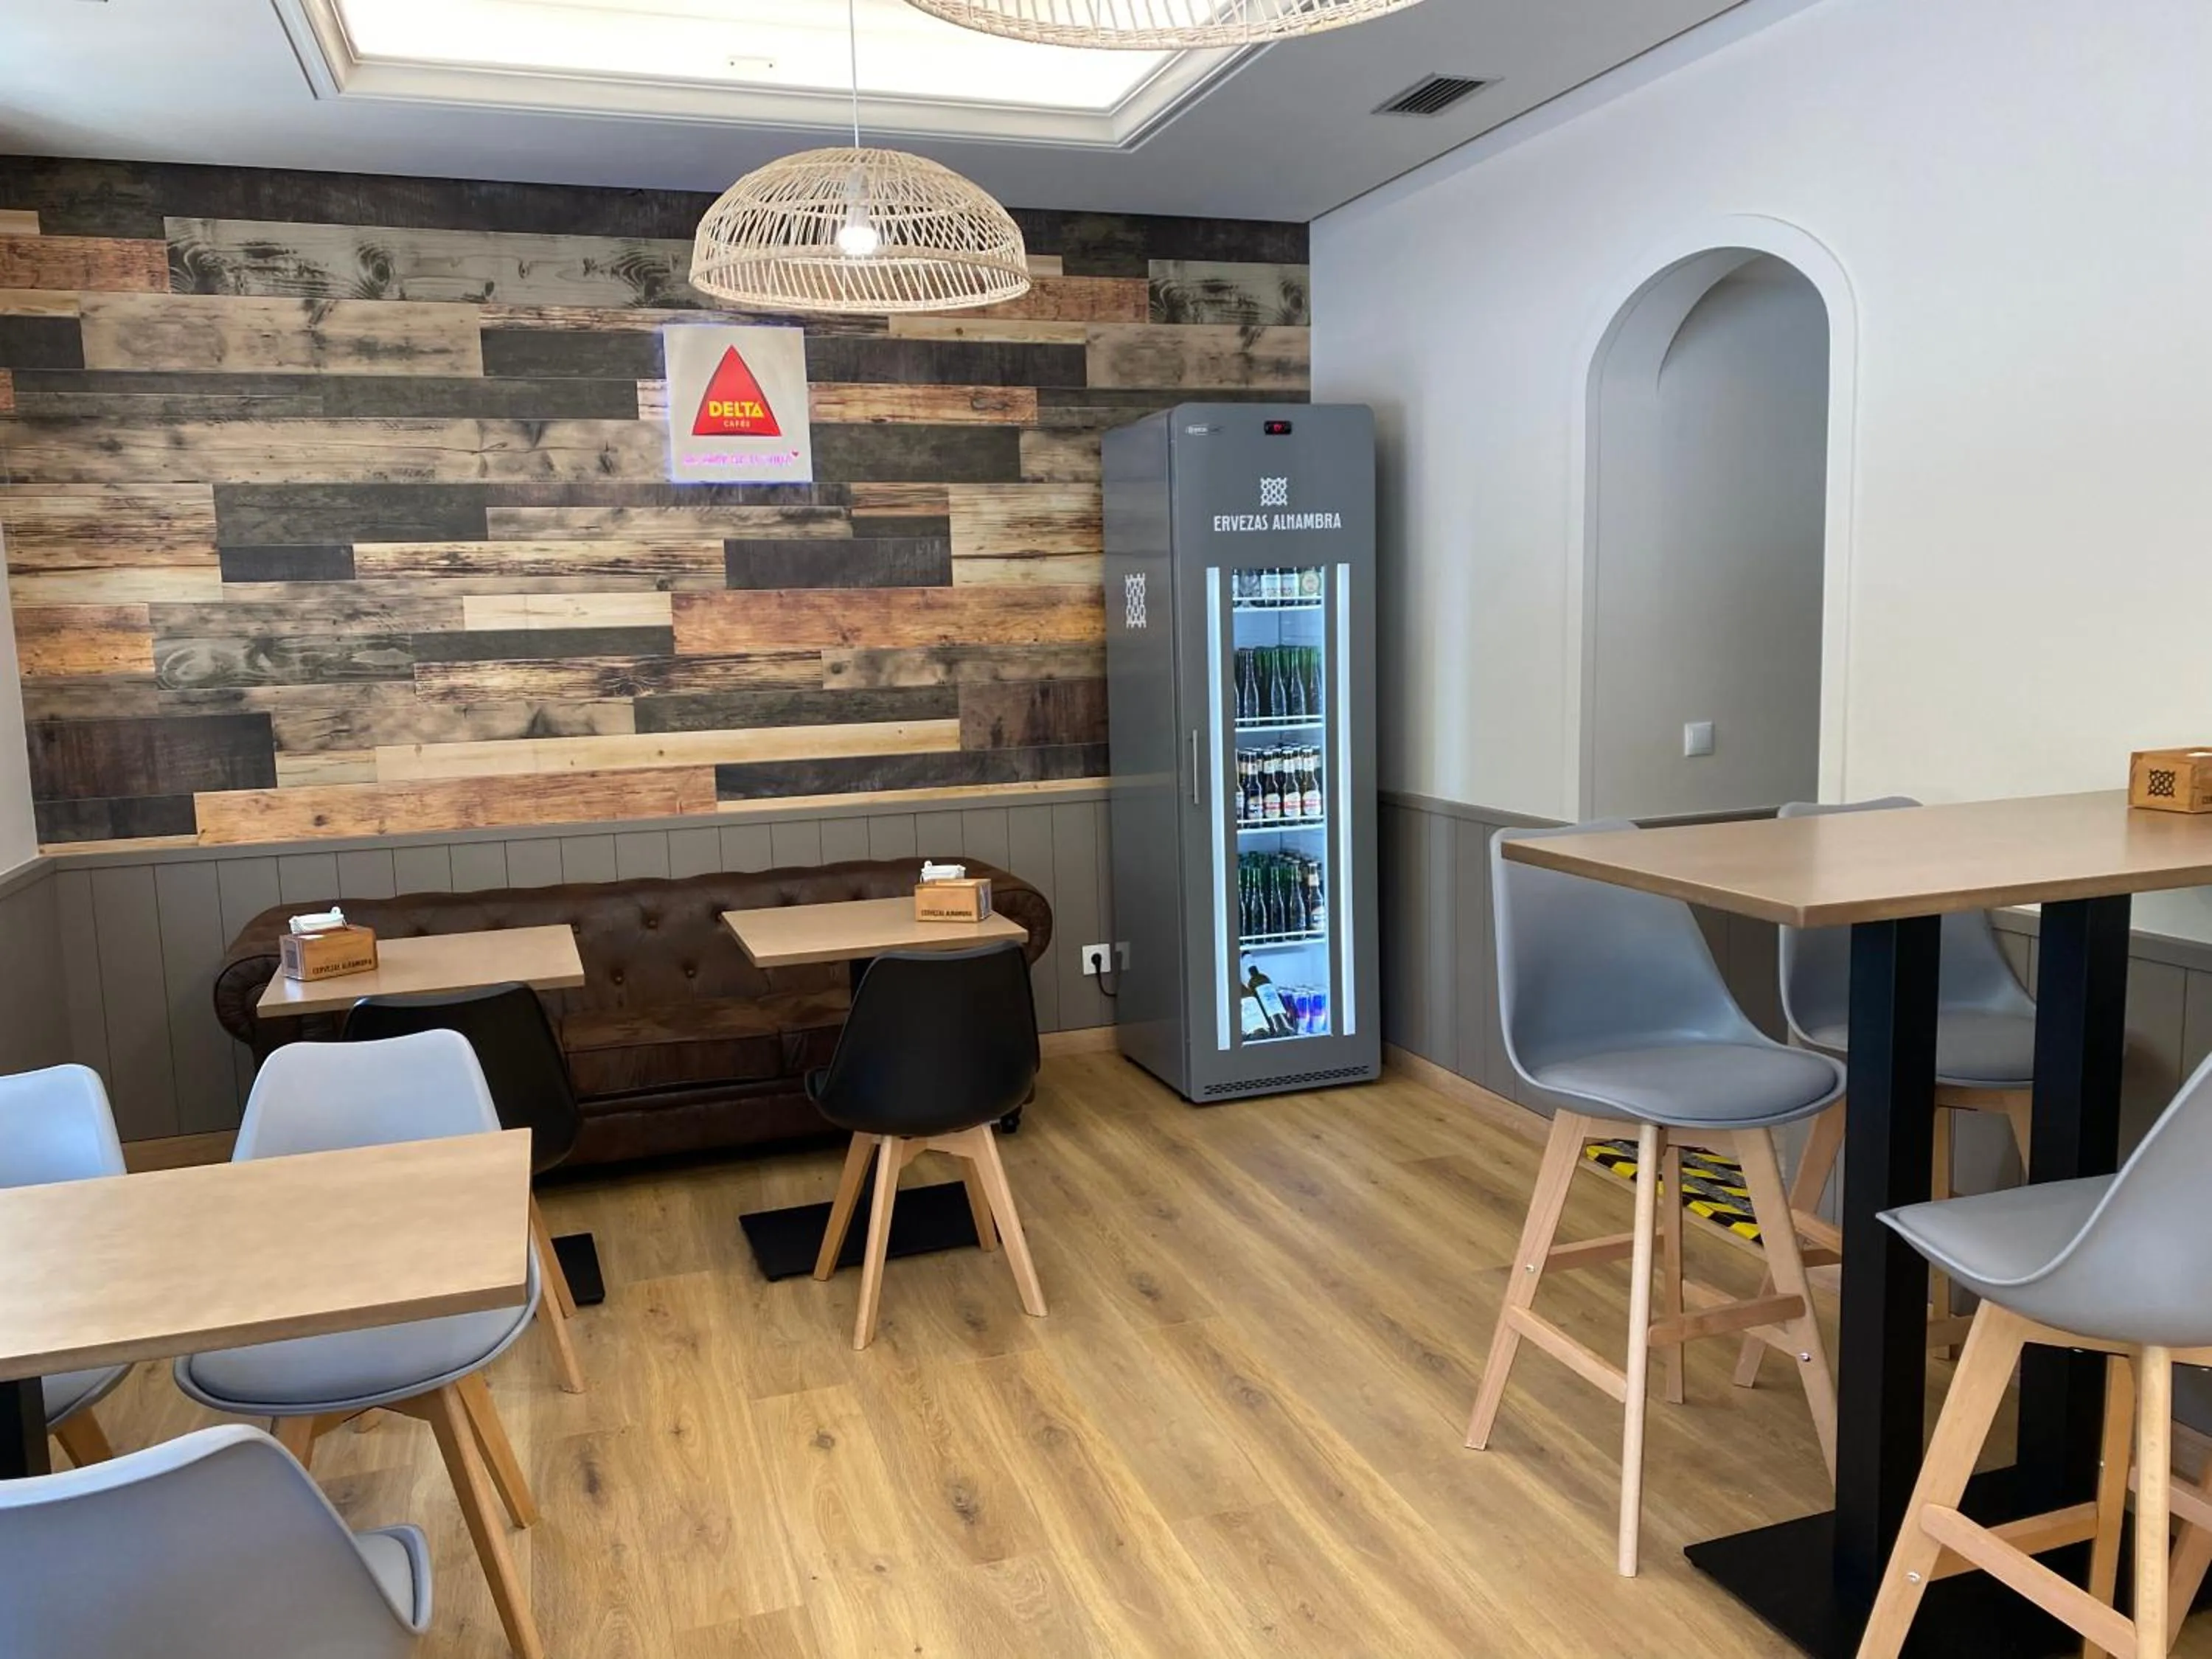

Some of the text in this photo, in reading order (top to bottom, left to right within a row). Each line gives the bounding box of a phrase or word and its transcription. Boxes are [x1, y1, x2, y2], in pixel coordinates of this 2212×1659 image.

[709, 400, 765, 418] DELTA
[1214, 512, 1342, 532] ERVEZAS ALHAMBRA
